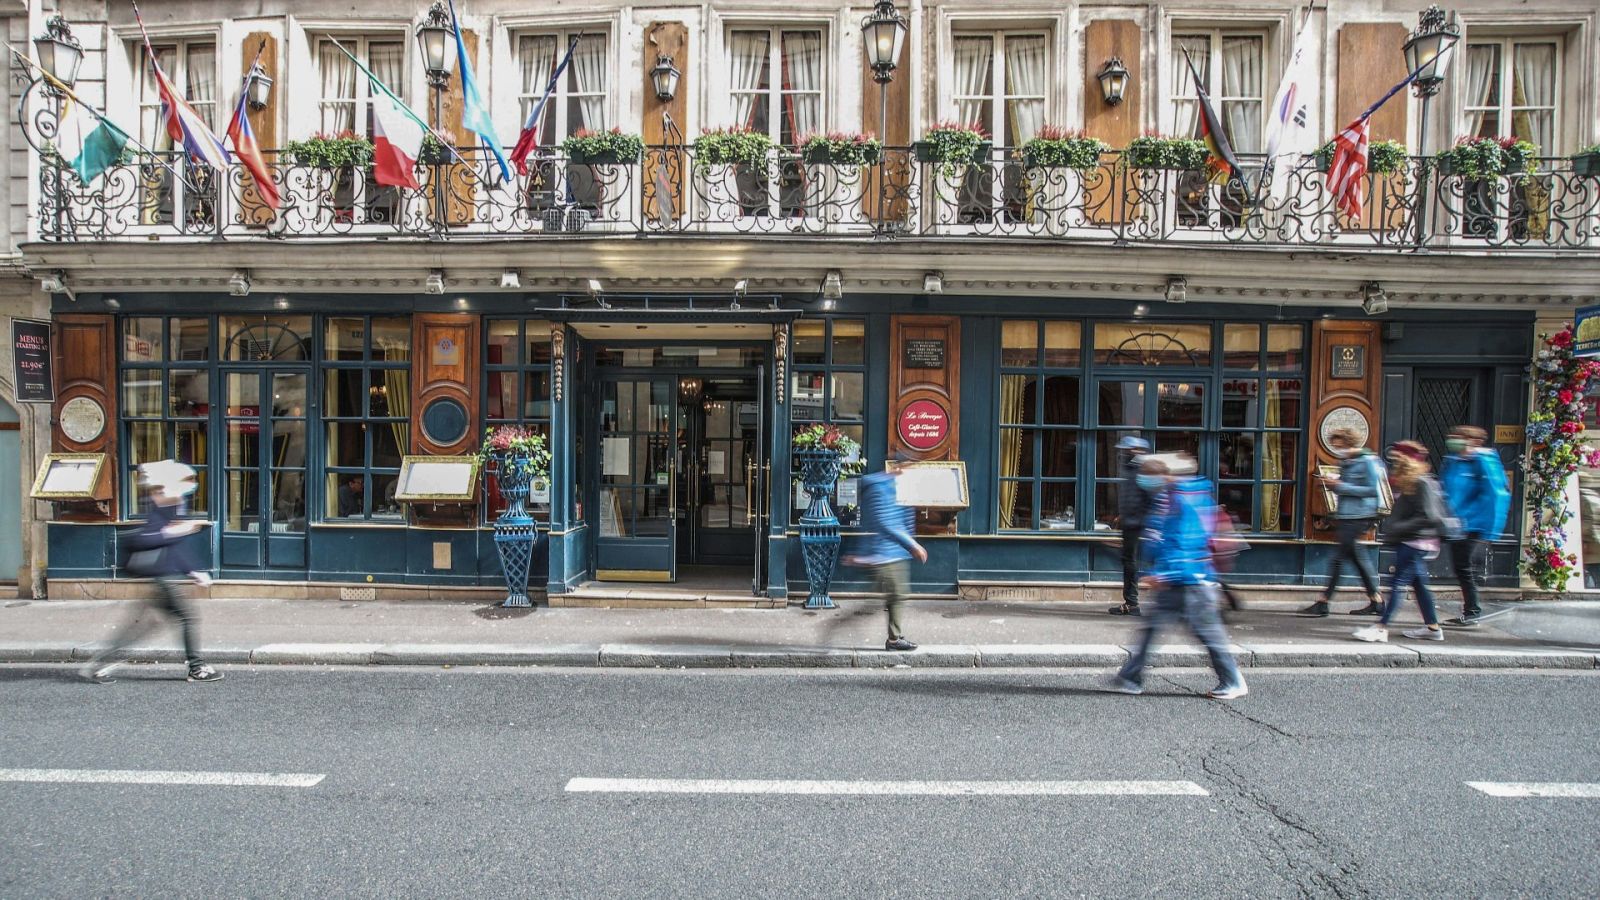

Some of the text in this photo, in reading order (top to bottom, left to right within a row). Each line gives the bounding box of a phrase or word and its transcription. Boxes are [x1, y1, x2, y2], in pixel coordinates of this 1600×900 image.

[19, 334, 44, 344] MENUS
[16, 342, 40, 350] STARTING
[906, 411, 917, 419] Le
